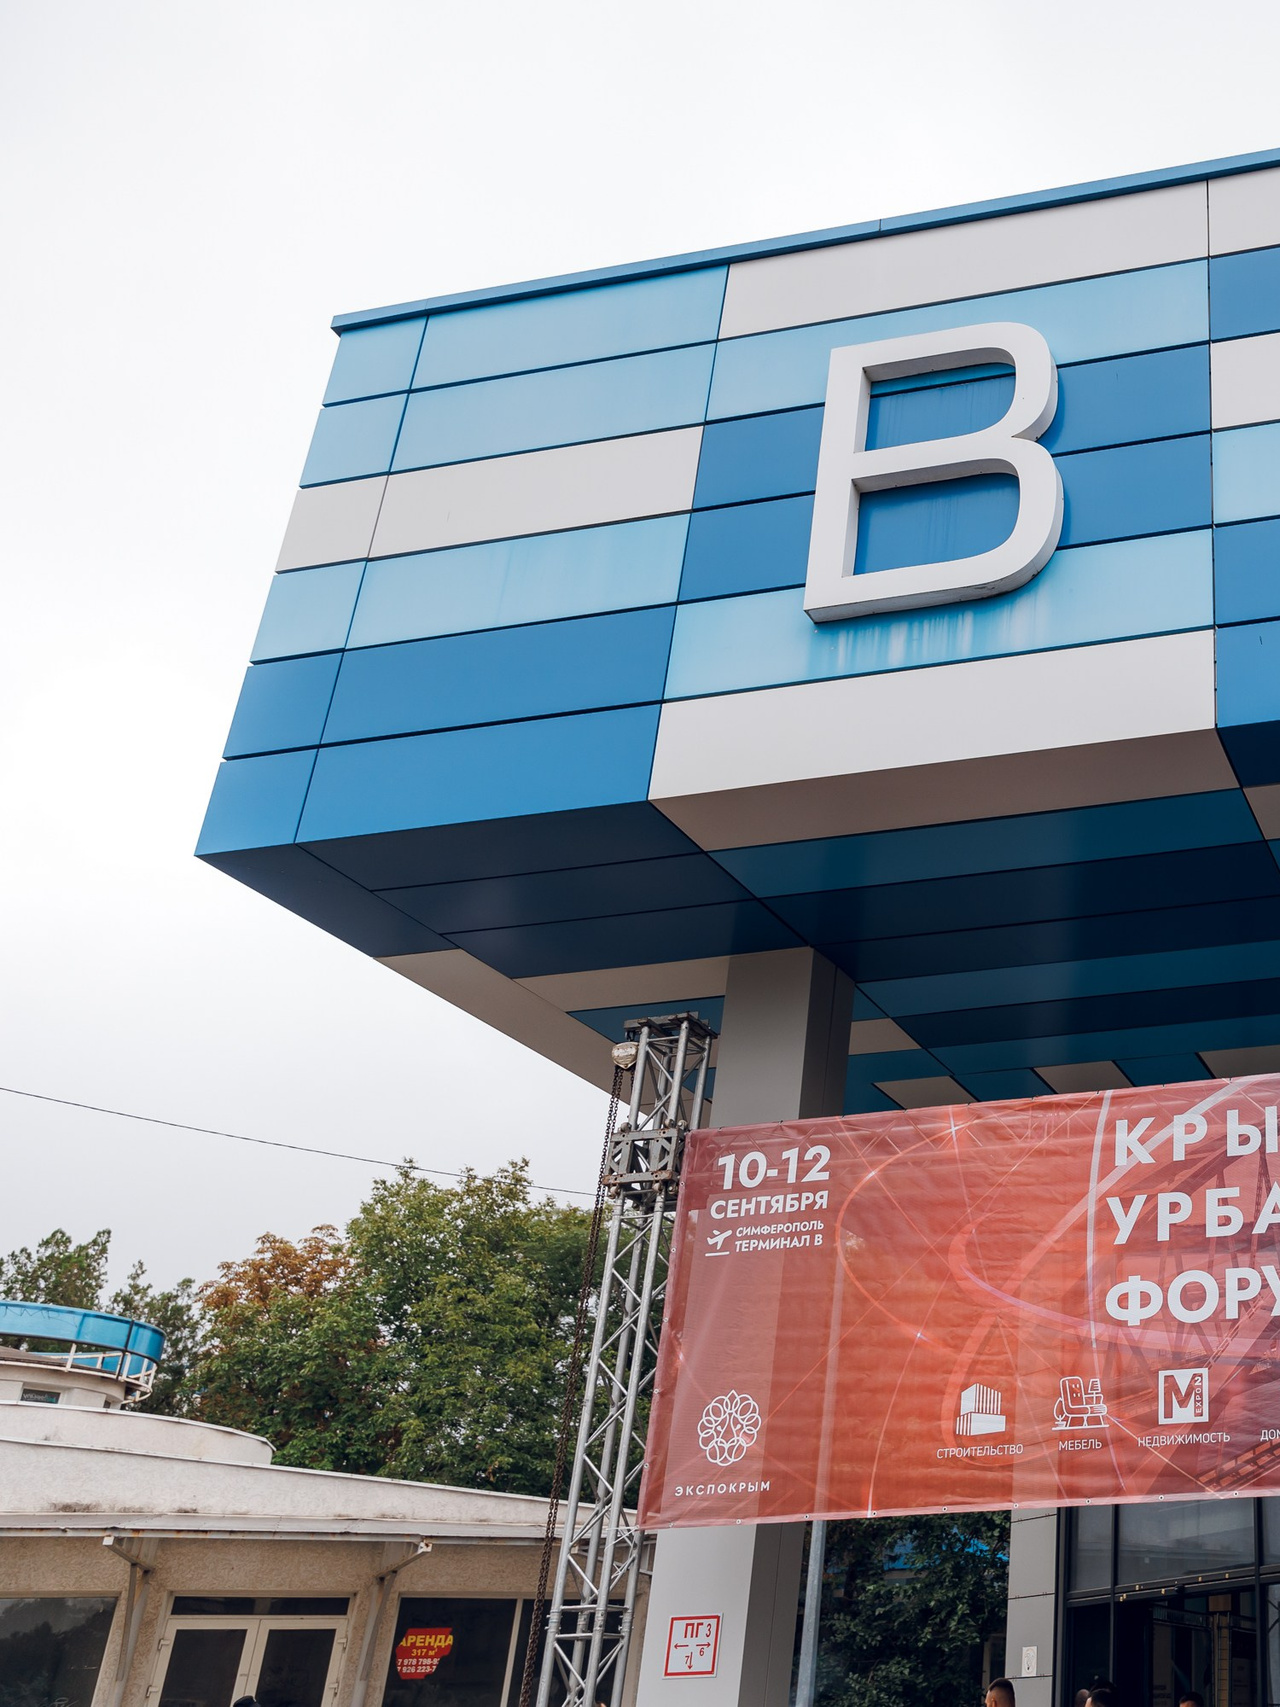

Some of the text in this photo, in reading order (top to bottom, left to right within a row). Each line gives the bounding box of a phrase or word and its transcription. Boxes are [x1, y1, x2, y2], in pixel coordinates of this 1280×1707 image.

[718, 1145, 831, 1190] 10-12
[710, 1190, 829, 1219] СЕНТЯБРЯ
[736, 1220, 825, 1237] СИМФЕРОПОЛЬ
[735, 1235, 810, 1252] ТЕРМИНАЛ
[1058, 1439, 1102, 1451] МЕБЕЛЬ
[1137, 1432, 1231, 1448] НЕДВИЖИМОСТЬ
[936, 1443, 1024, 1459] СТРОИТЕЛЬСТВО
[674, 1480, 771, 1496] ЭКСПОКРЫМ
[683, 1622, 712, 1638] ПГ 3
[400, 1635, 454, 1648] АРЕНДА
[685, 1655, 690, 1664] 7
[699, 1647, 705, 1656] 6
